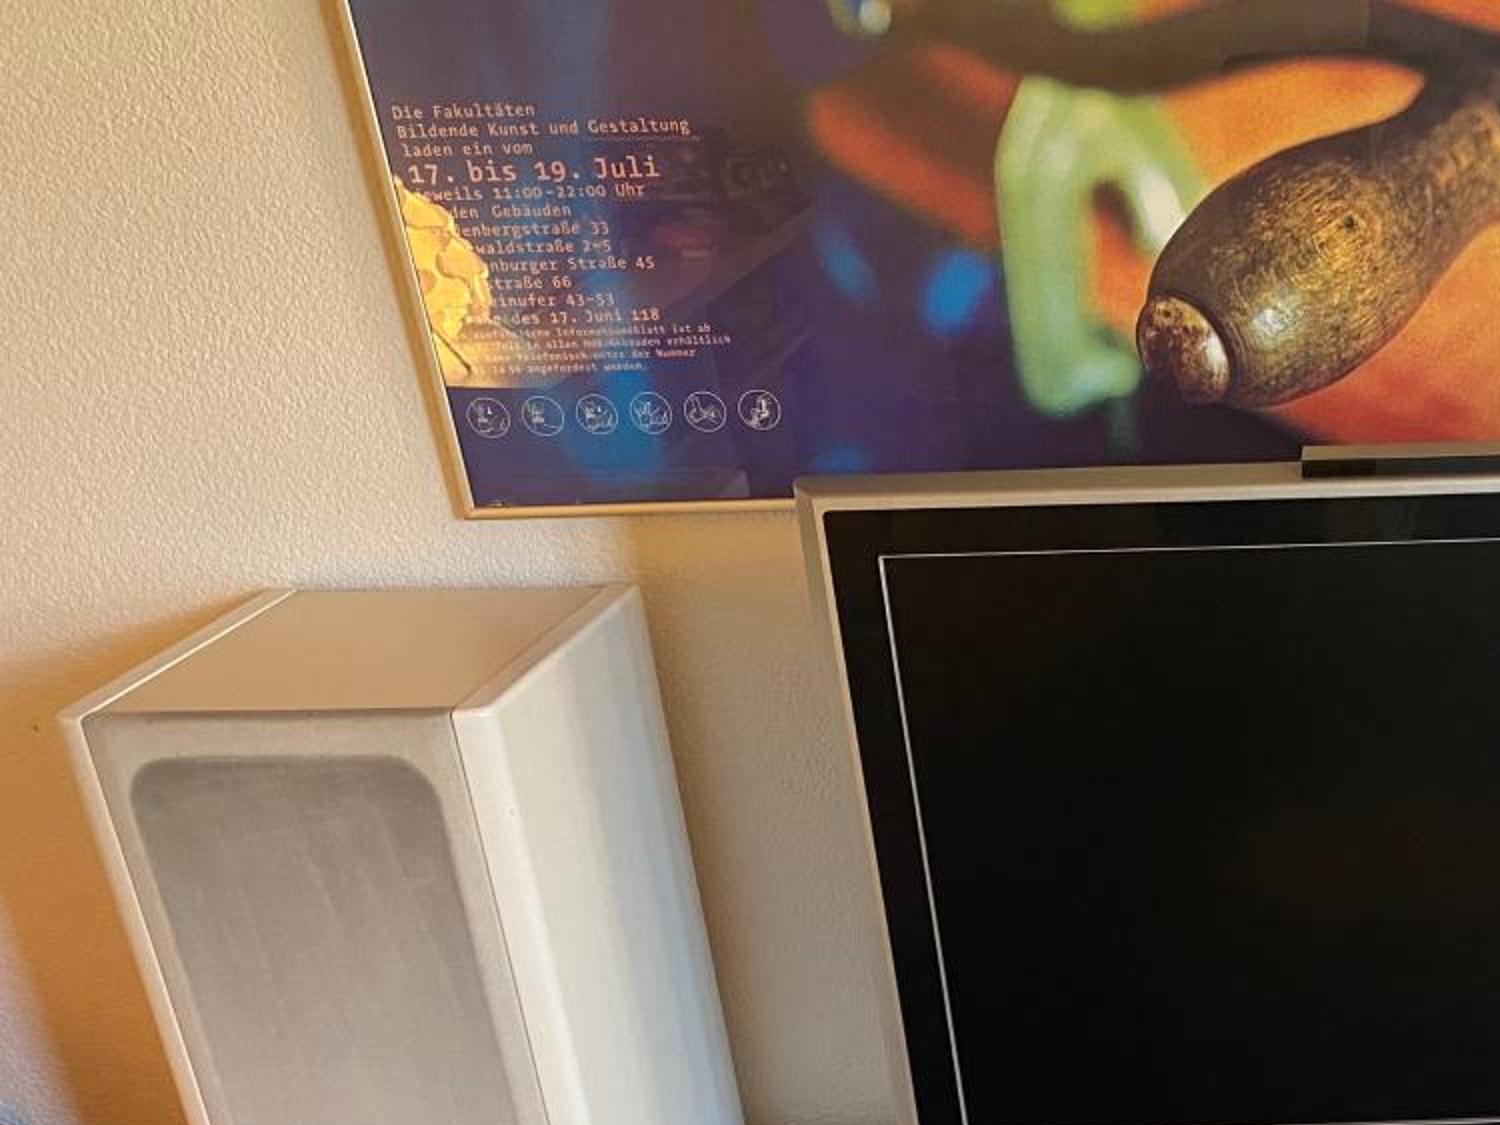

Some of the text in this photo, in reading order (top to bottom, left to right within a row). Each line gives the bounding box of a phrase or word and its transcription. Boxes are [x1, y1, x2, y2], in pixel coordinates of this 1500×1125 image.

[391, 103, 535, 120] Die Fakultäten
[396, 117, 692, 139] Bildende Kunst und Gestaltung
[402, 142, 534, 158] laden ein vom
[407, 155, 661, 185] 17. bis 19. Juli
[615, 182, 645, 198] Uhr
[590, 221, 610, 236] 33
[474, 238, 612, 255] waldstraße 2-5
[490, 257, 656, 274] nburger Straße 45
[552, 276, 573, 290] 66
[511, 311, 541, 326] des
[550, 311, 578, 325] 17.
[586, 308, 623, 323] Juni
[631, 306, 662, 322] 118
